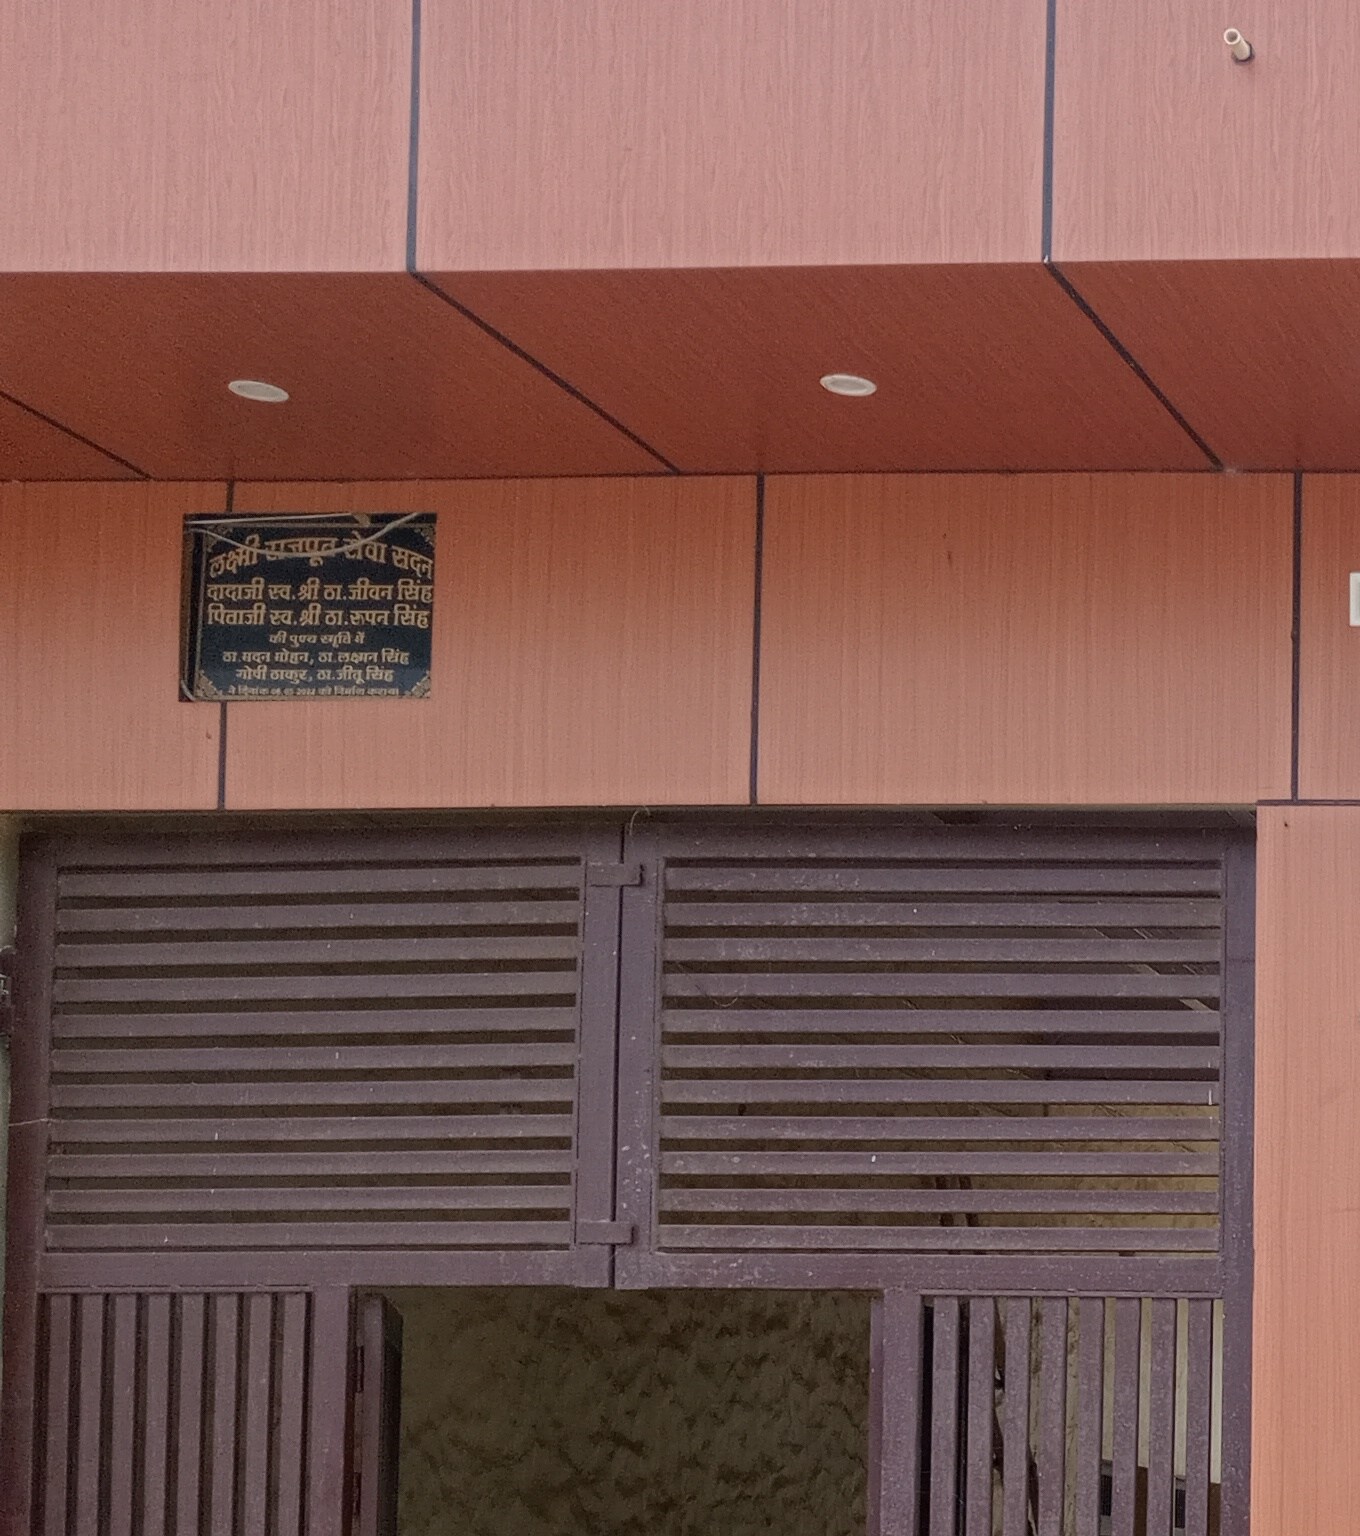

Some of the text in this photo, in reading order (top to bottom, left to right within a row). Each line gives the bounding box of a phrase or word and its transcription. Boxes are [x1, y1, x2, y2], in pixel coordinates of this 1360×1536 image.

[209, 533, 261, 578] लक्ष्मी
[391, 545, 434, 580] सदन
[206, 577, 265, 601] दादाजी
[397, 578, 434, 604] सिंह
[207, 603, 267, 625] पिताजी
[393, 603, 431, 629] सिंह
[269, 630, 287, 644] की
[381, 648, 410, 666] सिंह
[368, 665, 396, 683] सिंह
